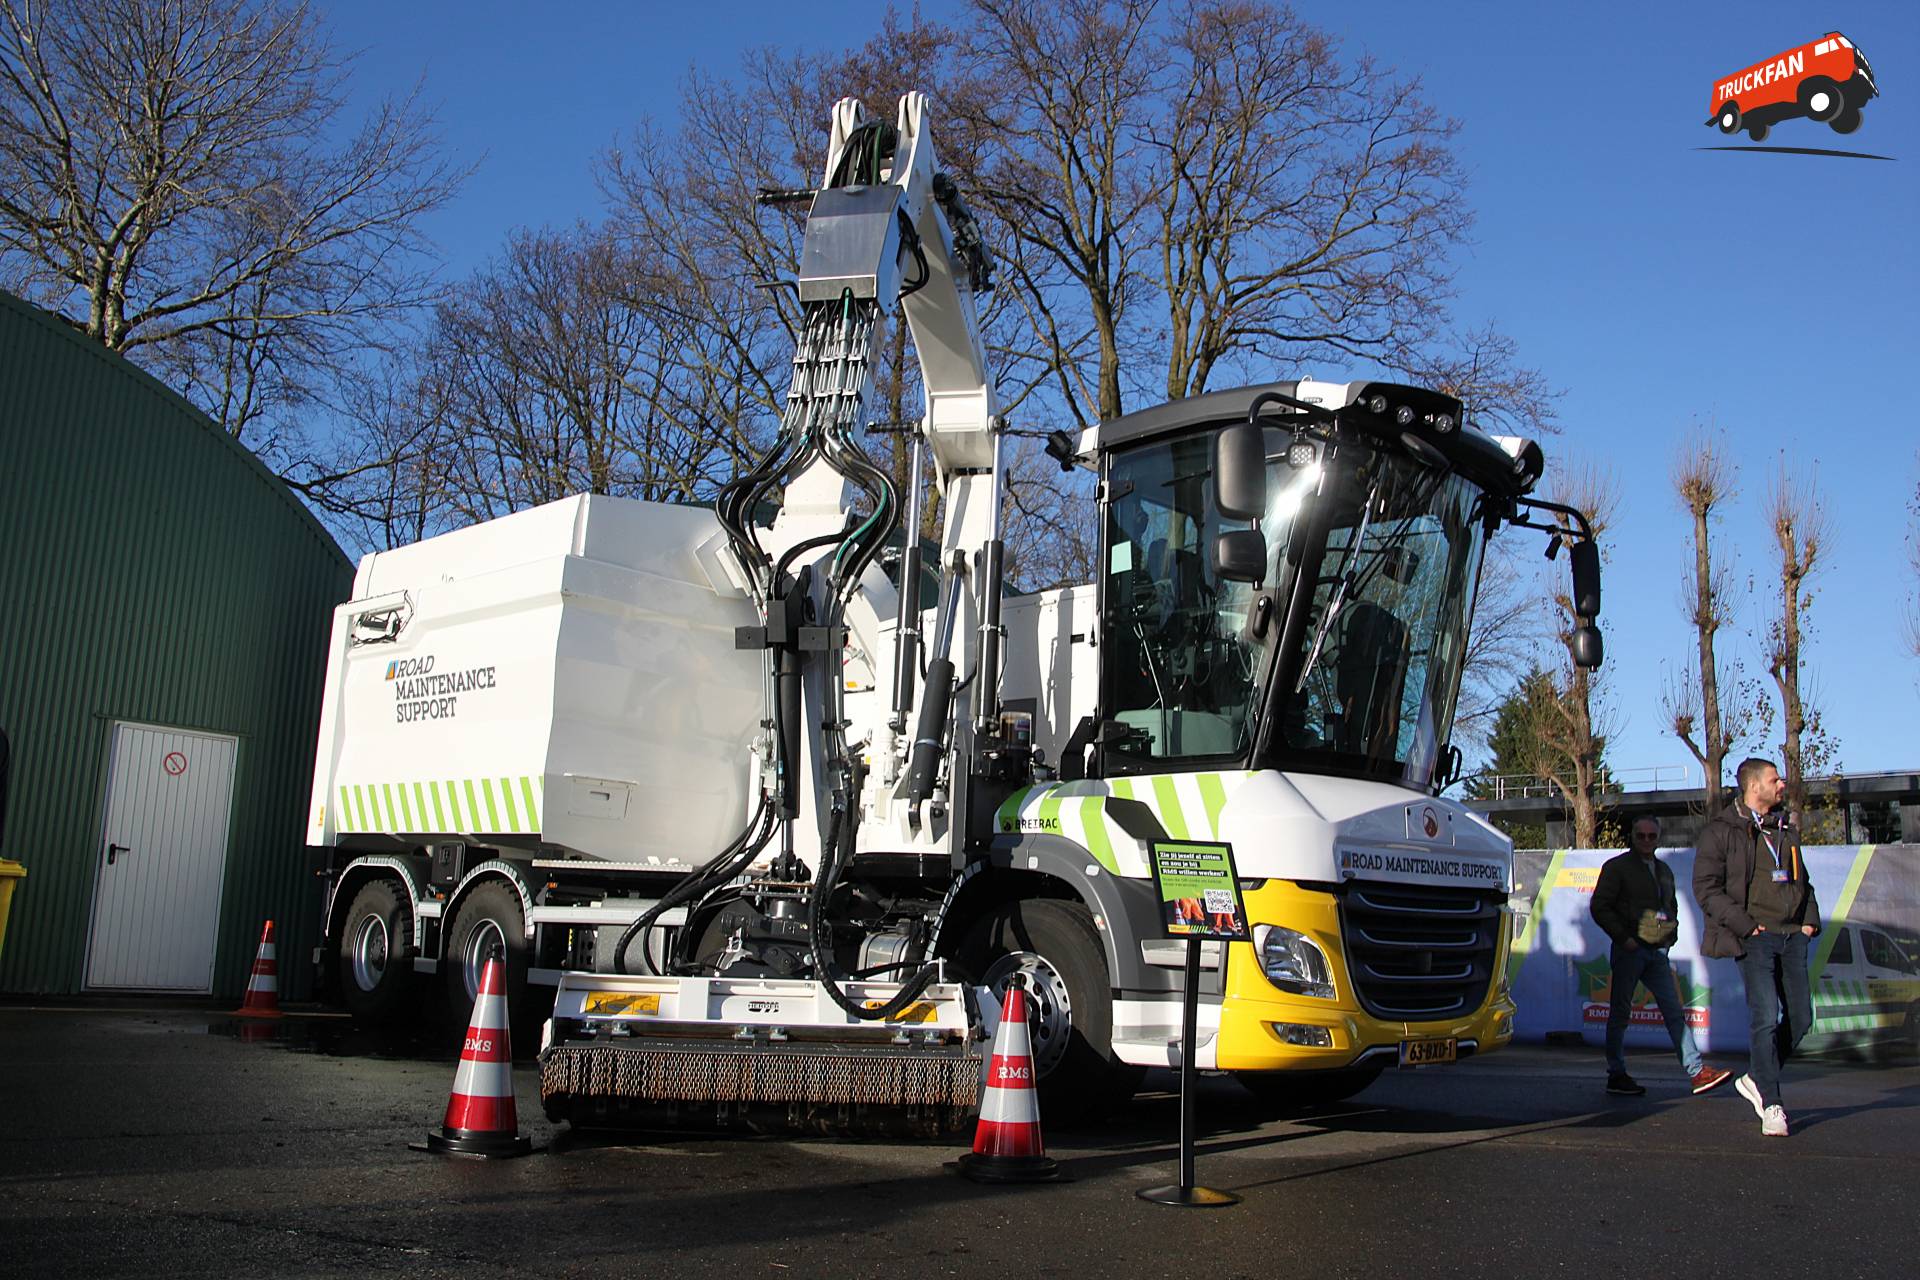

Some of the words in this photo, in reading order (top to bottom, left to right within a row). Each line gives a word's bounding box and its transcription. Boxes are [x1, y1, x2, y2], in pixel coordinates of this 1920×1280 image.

[397, 655, 434, 678] ROAD
[395, 666, 496, 700] MAINTENANCE
[396, 696, 457, 723] SUPPORT
[1015, 817, 1058, 830] BRETRAC
[1352, 853, 1383, 870] ROAD
[1385, 856, 1460, 876] MAINTENANCE
[1461, 864, 1503, 880] SUPPORT
[464, 1038, 492, 1052] RMS
[998, 1066, 1030, 1079] RMS
